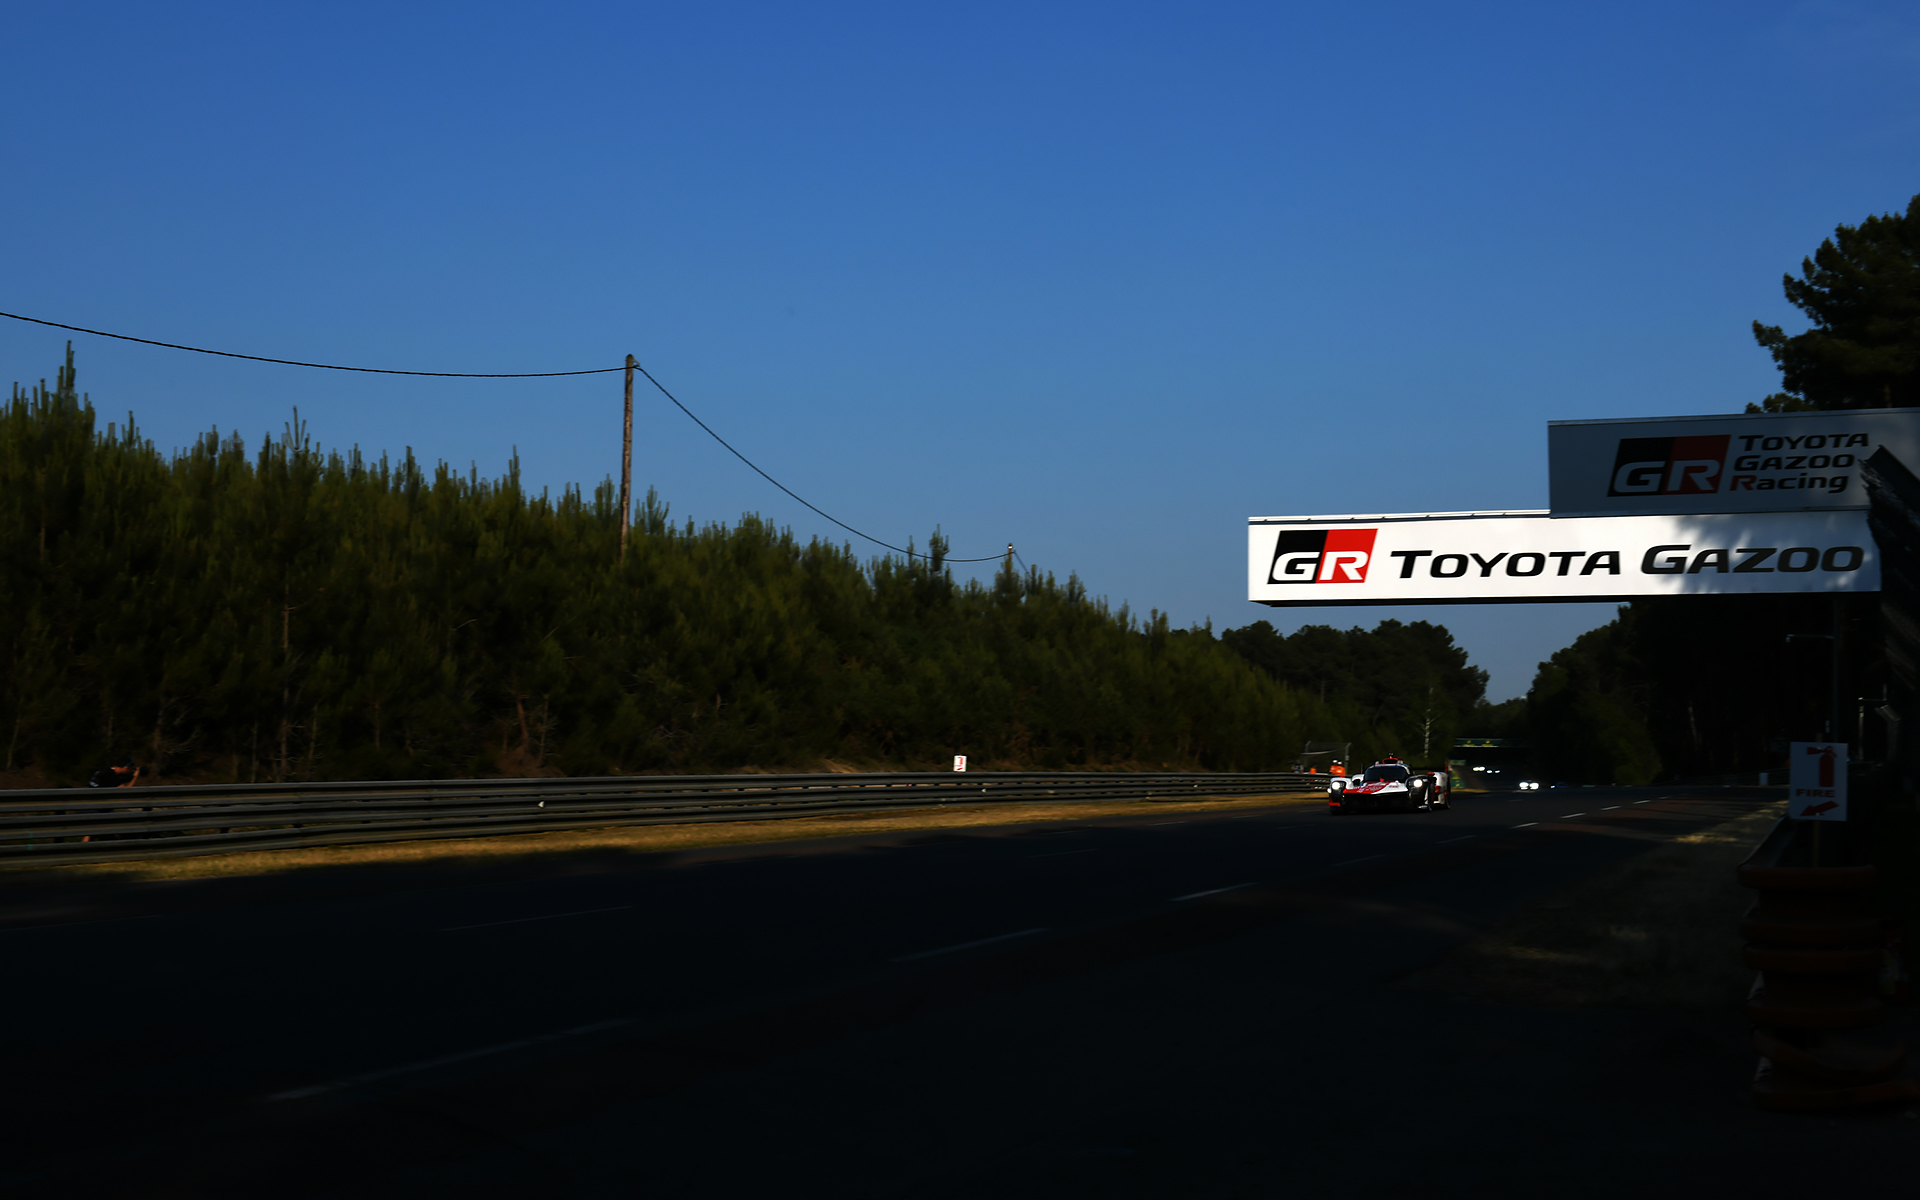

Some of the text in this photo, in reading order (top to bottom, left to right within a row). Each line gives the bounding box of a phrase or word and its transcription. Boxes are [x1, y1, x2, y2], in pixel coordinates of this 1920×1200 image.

[1738, 433, 1869, 451] TOYOTA
[1734, 454, 1855, 471] GAZOO
[1613, 459, 1721, 493] GR
[1729, 473, 1849, 494] Racing
[1272, 544, 1864, 581] GR TOYOTA GAZOO
[1796, 789, 1835, 798] FIRE
